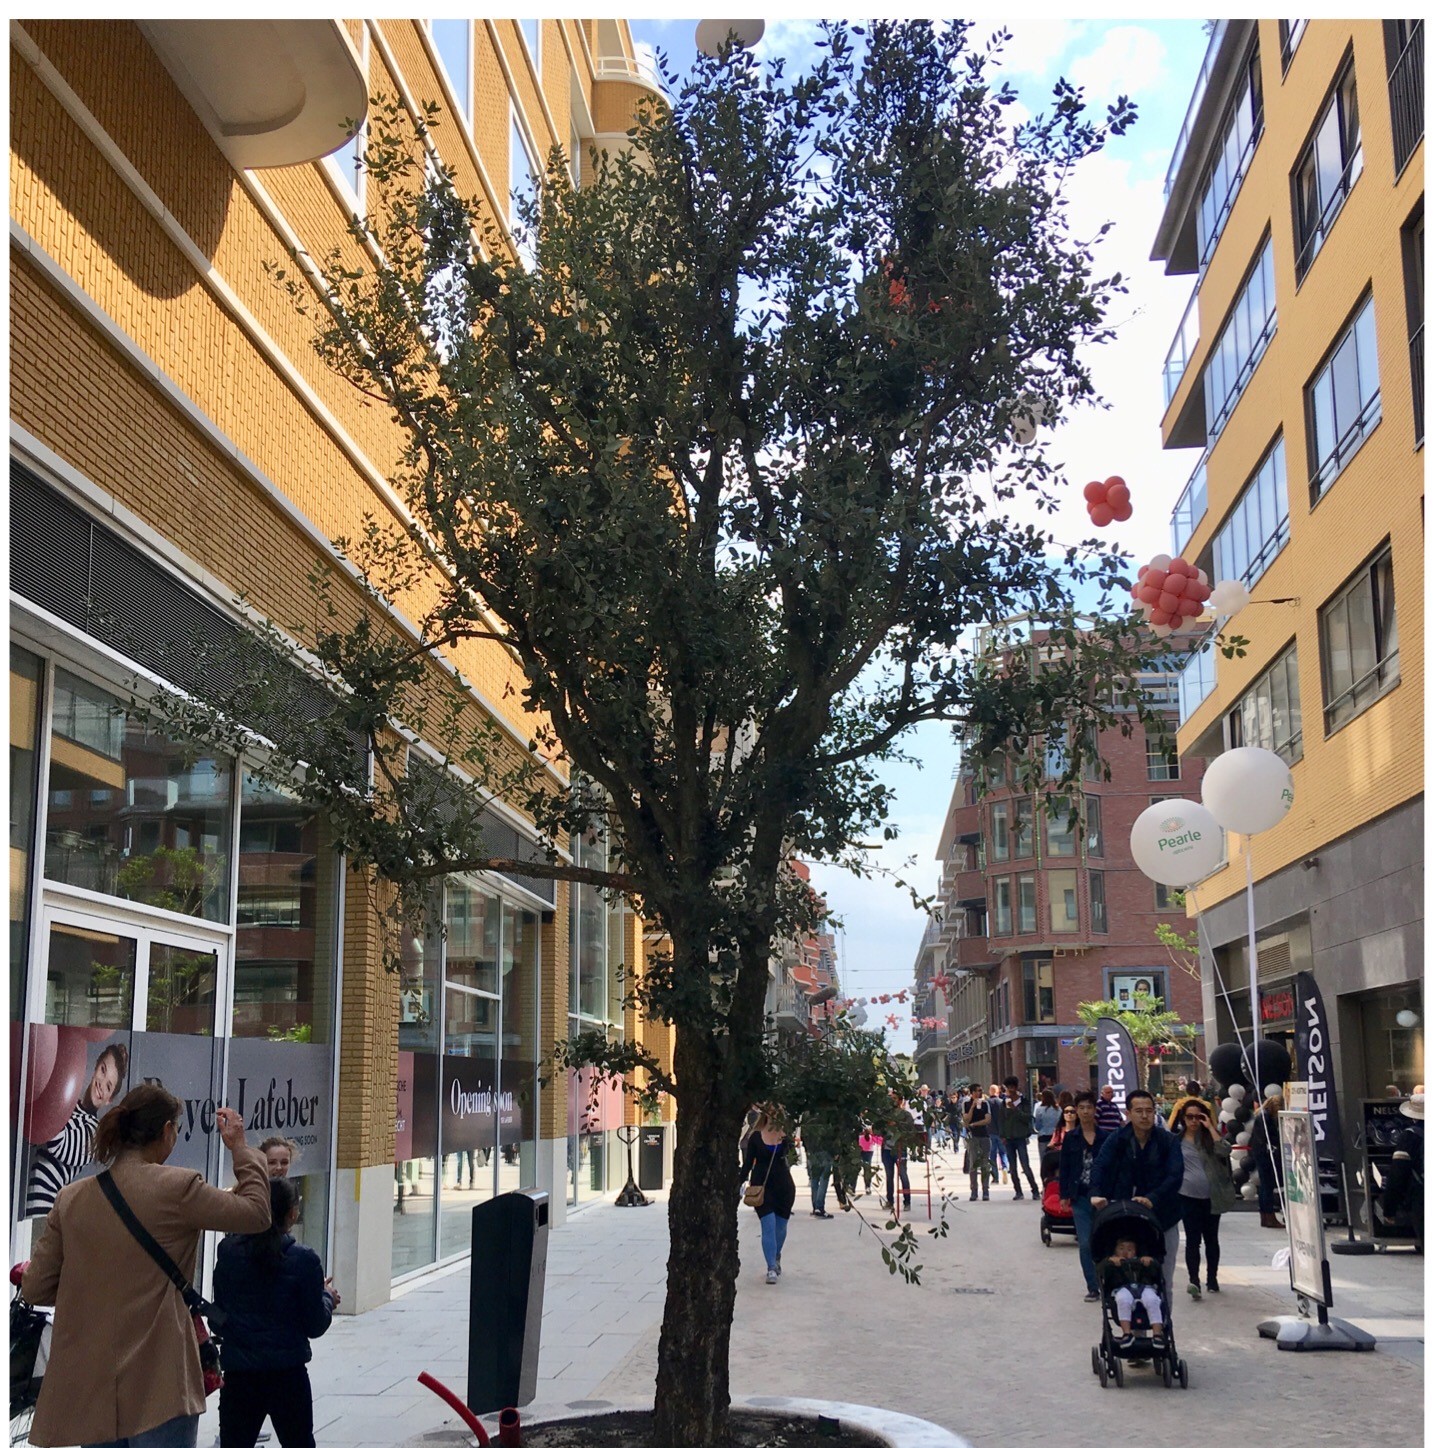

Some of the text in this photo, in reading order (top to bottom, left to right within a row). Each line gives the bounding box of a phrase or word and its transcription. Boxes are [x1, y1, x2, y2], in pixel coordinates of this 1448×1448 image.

[1158, 830, 1201, 851] Pearle
[239, 1077, 319, 1130] Lafeber
[451, 1078, 491, 1119] Opening
[1373, 1106, 1398, 1115] NELS
